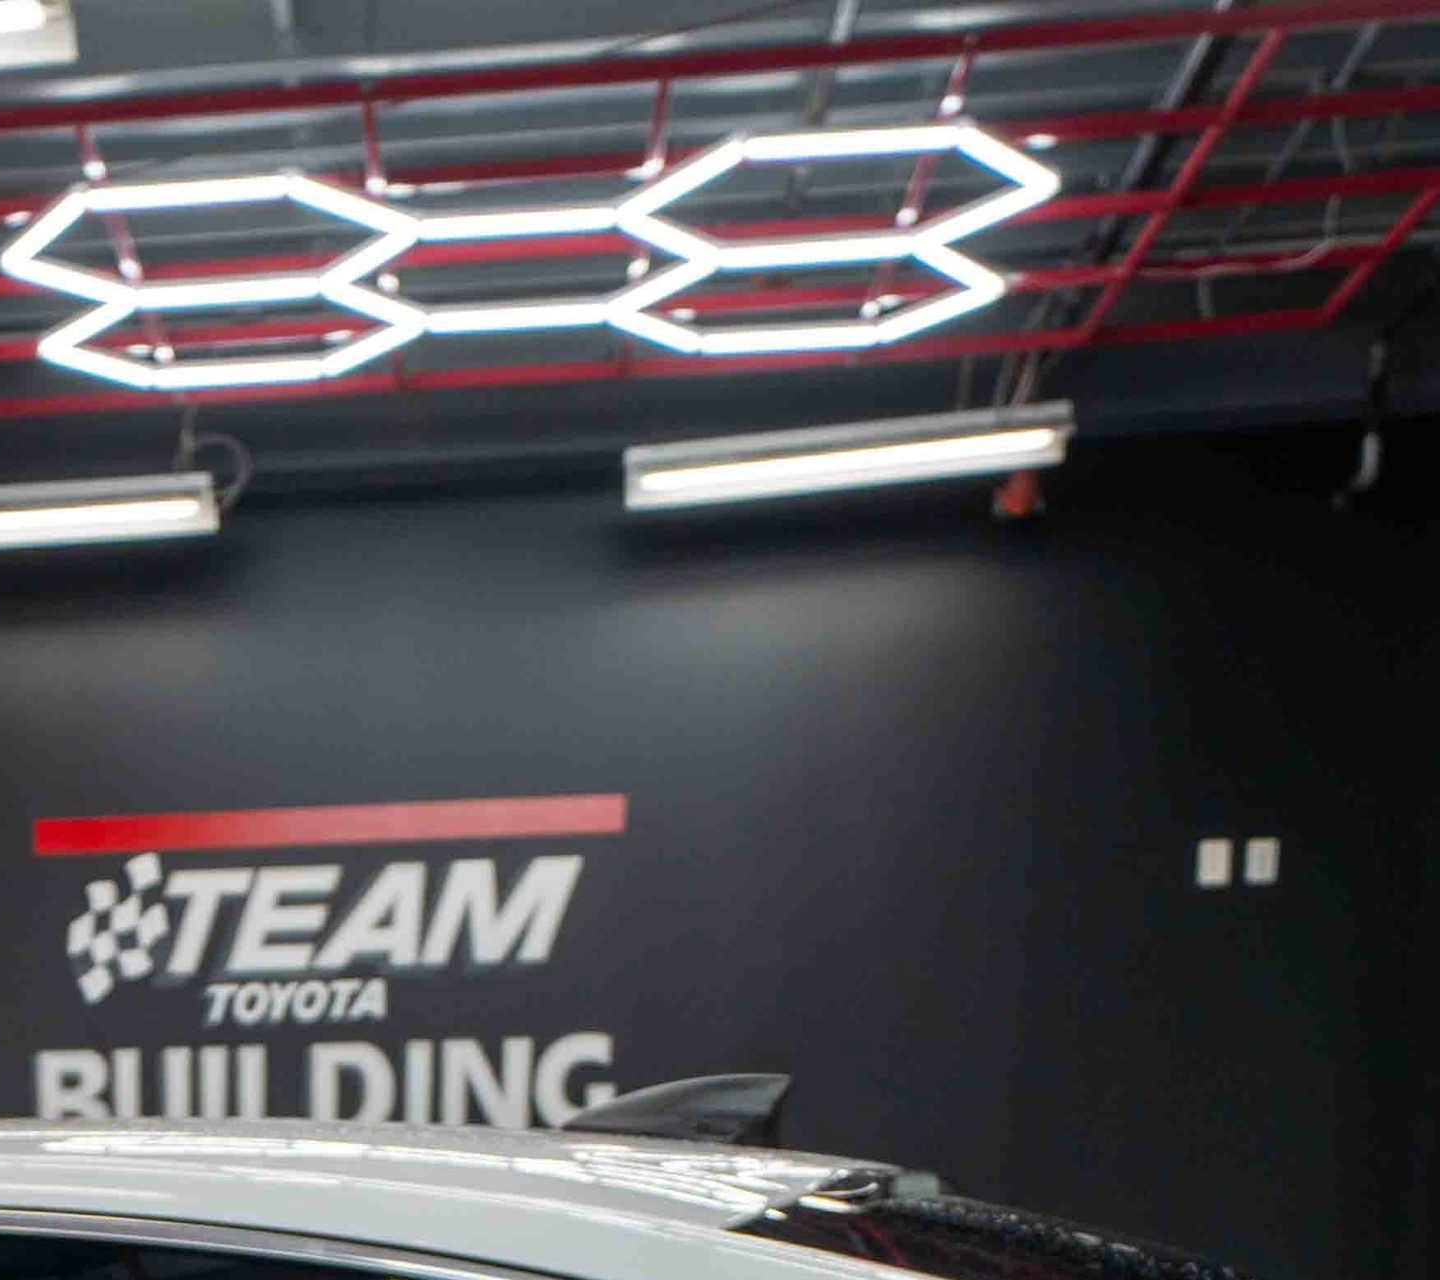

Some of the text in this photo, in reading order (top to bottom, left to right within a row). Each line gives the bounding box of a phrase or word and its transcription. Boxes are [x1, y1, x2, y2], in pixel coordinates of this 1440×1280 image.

[162, 856, 582, 975] TEAM
[204, 978, 387, 1025] TOYOTA
[35, 1032, 617, 1128] BUILDING
